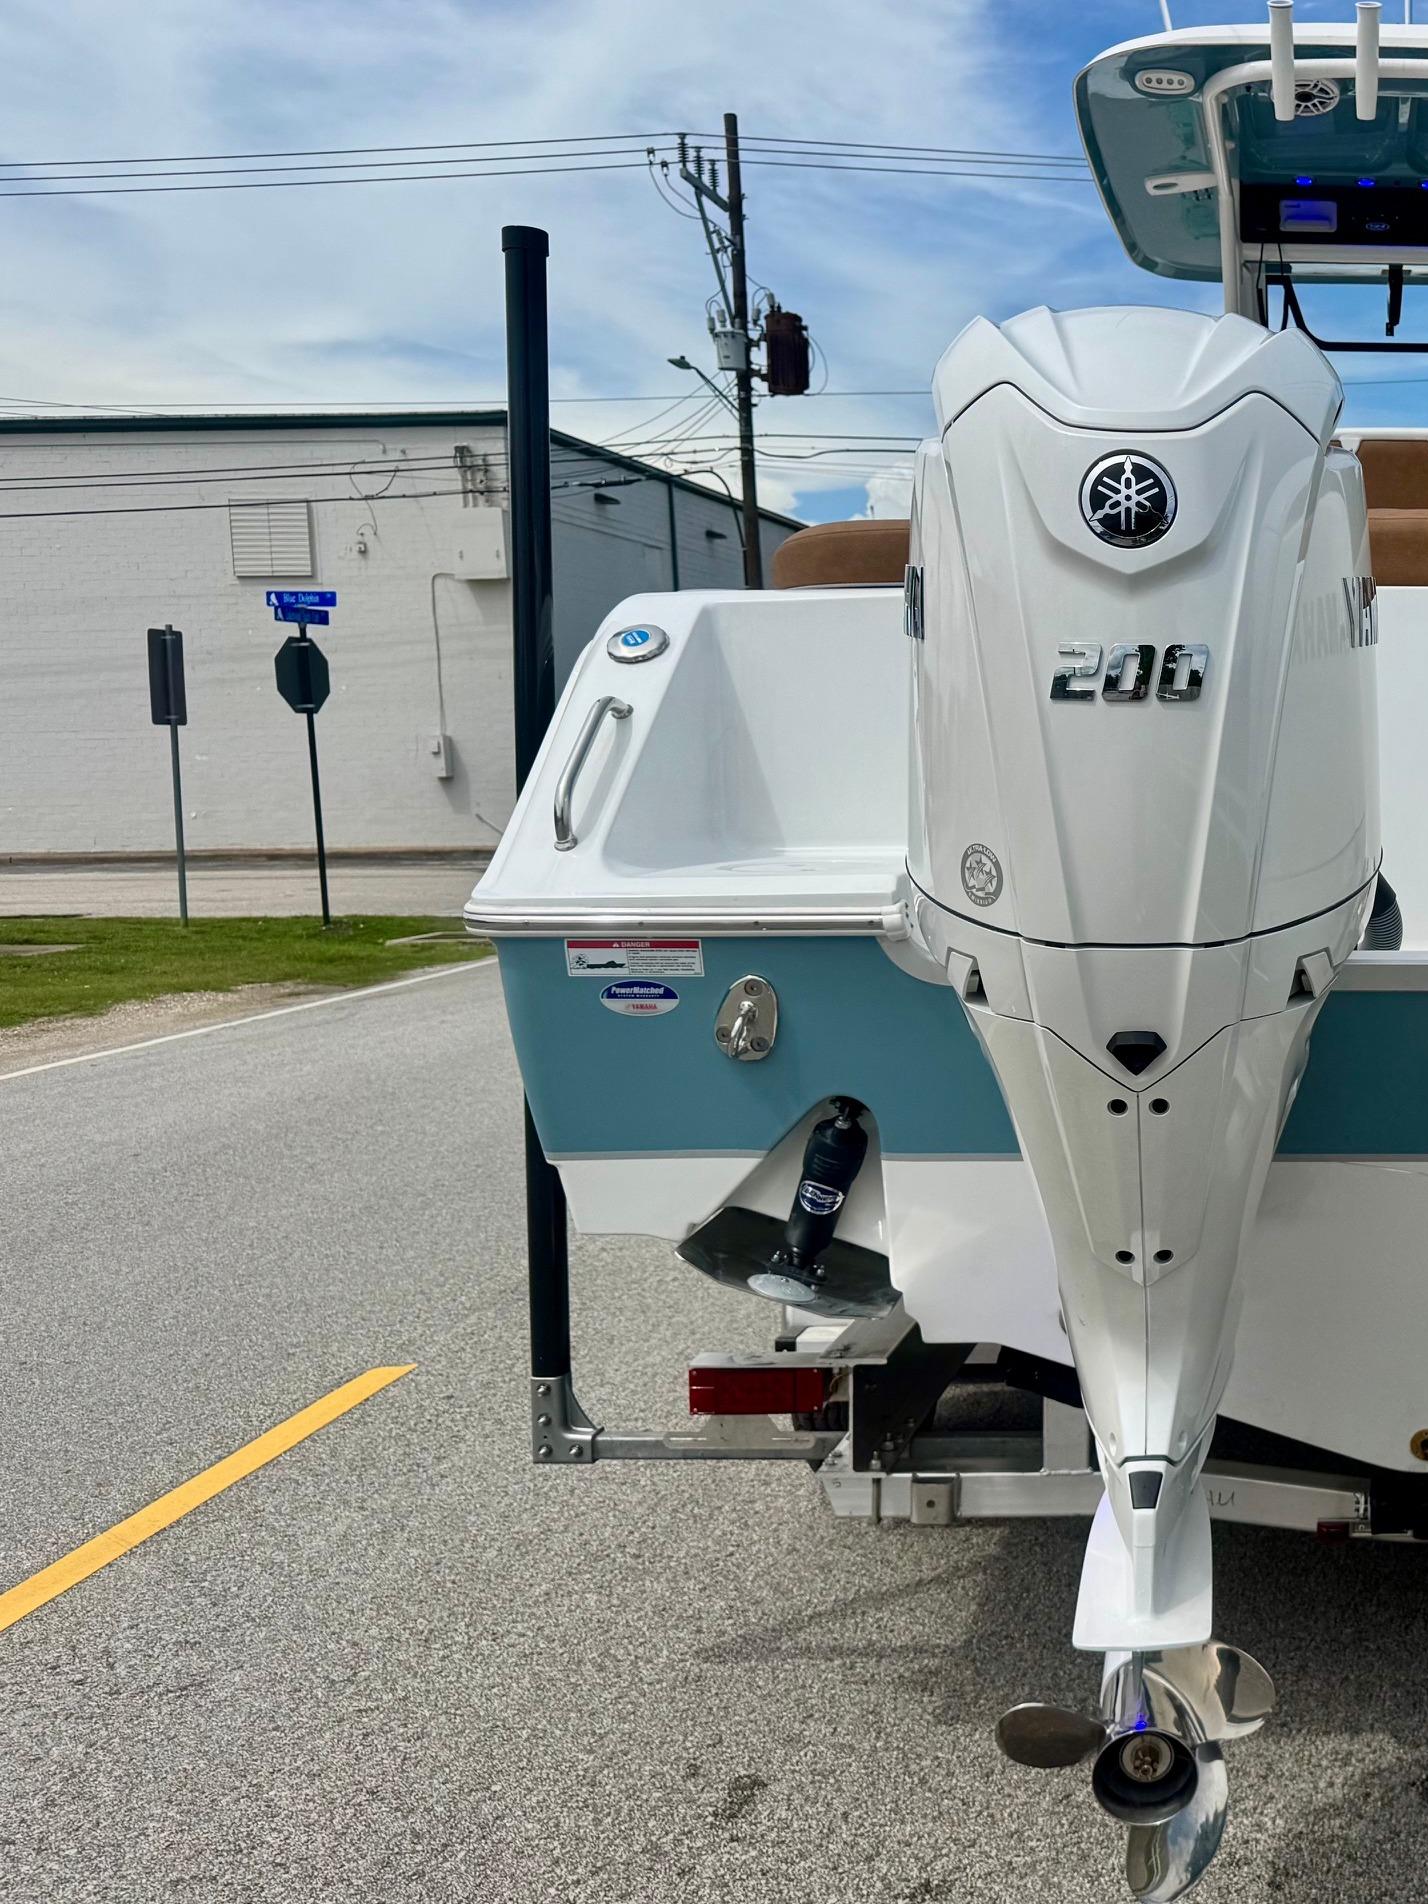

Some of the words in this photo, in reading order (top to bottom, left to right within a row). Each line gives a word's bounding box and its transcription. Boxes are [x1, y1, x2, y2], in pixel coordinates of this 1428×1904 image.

[283, 592, 296, 603] Blue
[1050, 641, 1211, 702] 200
[611, 986, 665, 995] PowerMatched
